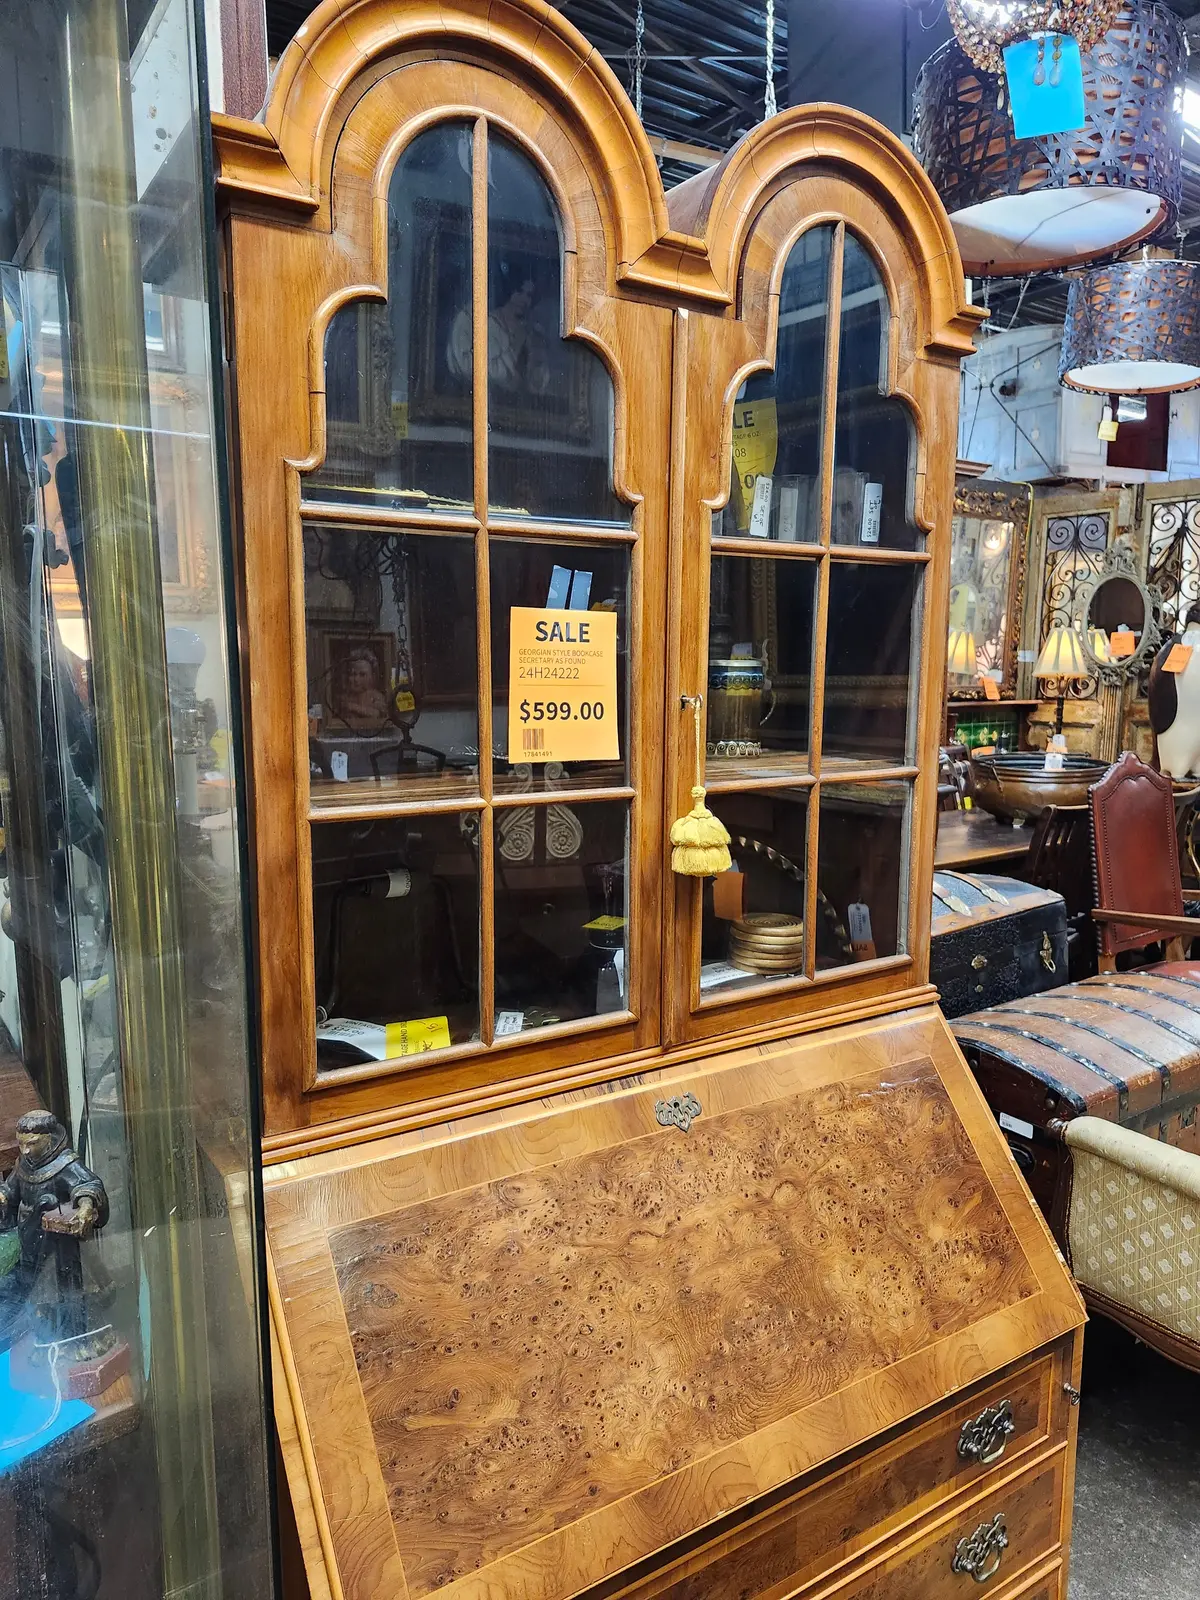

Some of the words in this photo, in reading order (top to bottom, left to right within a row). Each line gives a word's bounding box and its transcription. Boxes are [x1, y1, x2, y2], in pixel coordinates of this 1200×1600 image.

[733, 410, 755, 429] LE
[535, 620, 590, 643] SALE
[518, 648, 552, 656] GEORGIAN
[553, 649, 571, 657] STYLE
[518, 656, 555, 664] SECRETARY
[519, 666, 580, 679] 24H24222
[519, 699, 604, 723] $599.00
